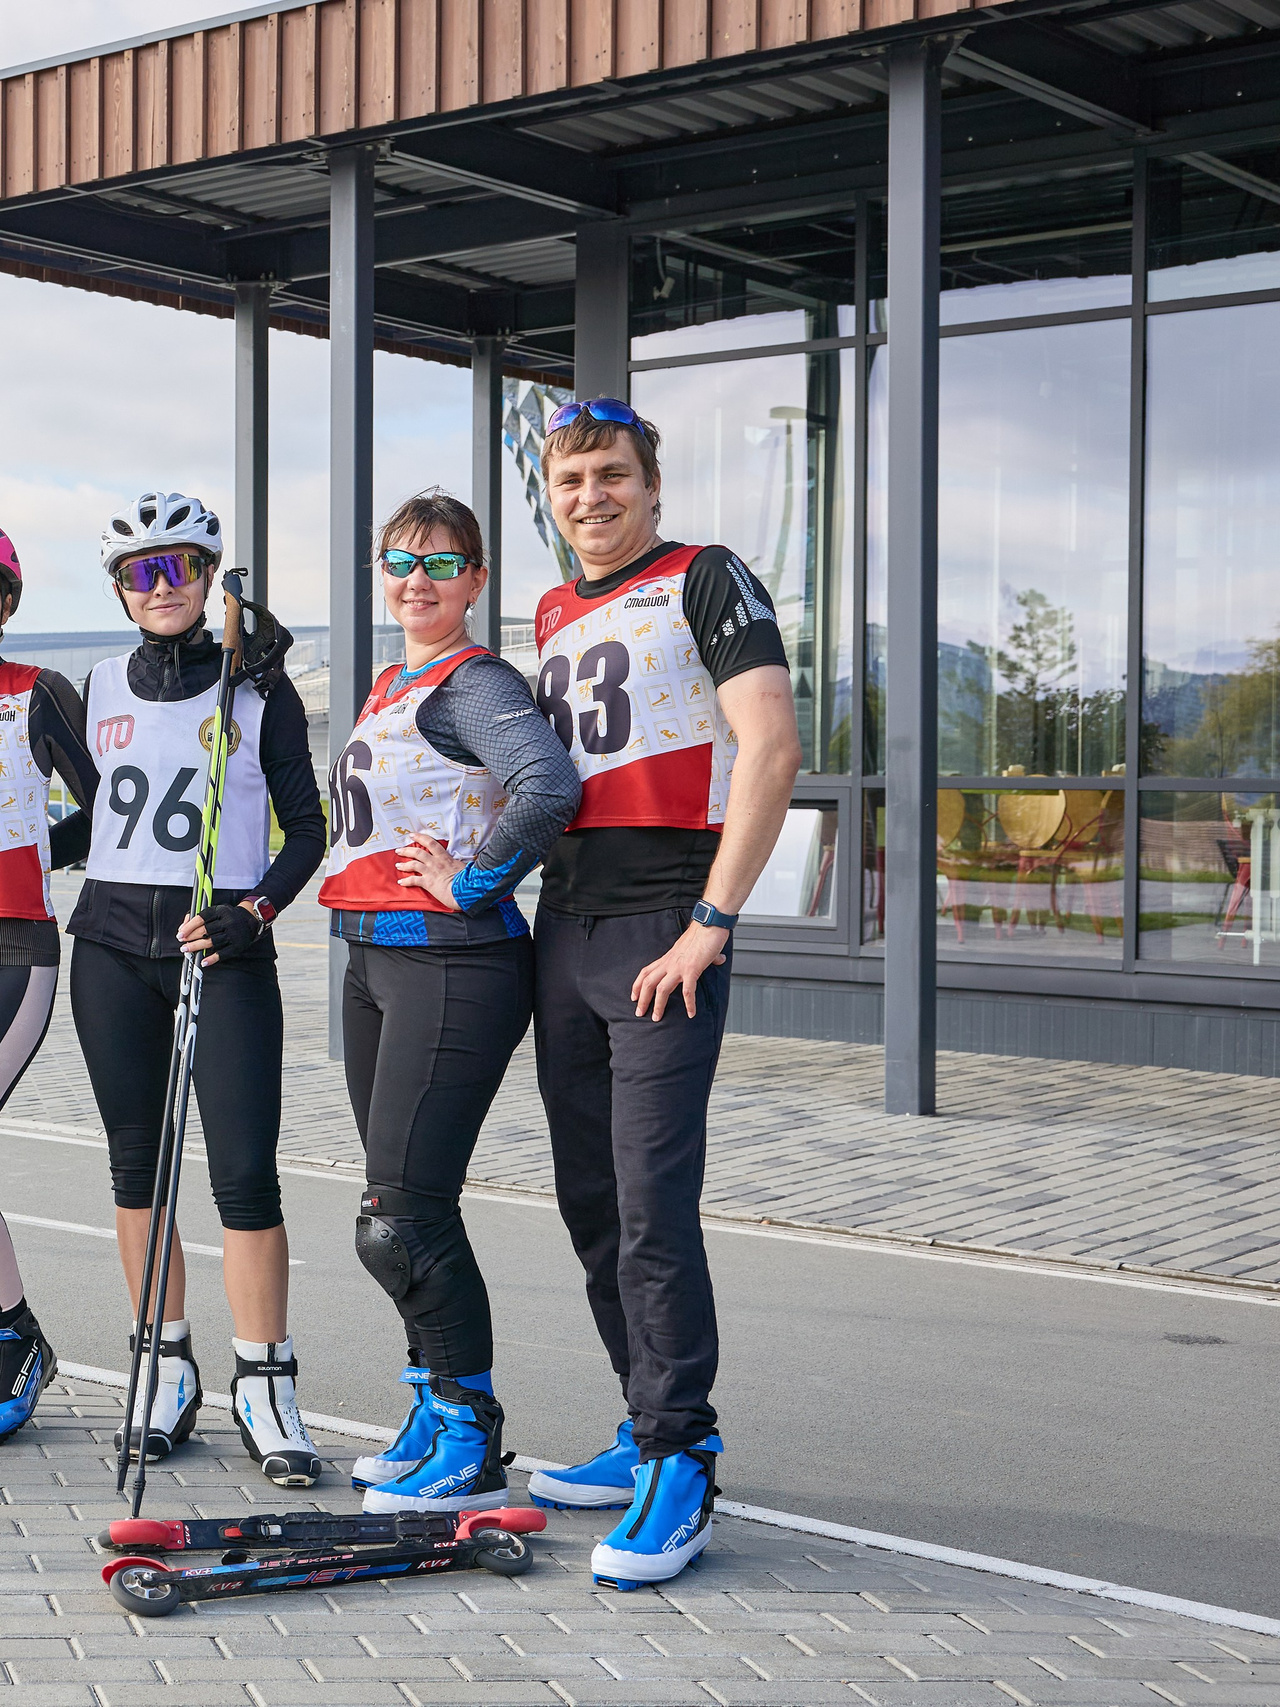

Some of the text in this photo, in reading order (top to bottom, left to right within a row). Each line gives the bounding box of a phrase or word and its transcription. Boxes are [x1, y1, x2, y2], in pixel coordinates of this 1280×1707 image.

[537, 641, 631, 754] 83
[109, 765, 203, 852] 96
[405, 1372, 430, 1380] SPINE
[432, 1400, 459, 1416] SPINE
[418, 1462, 479, 1499] SPINE
[661, 1507, 701, 1554] SPINE
[287, 1565, 371, 1586] JET
